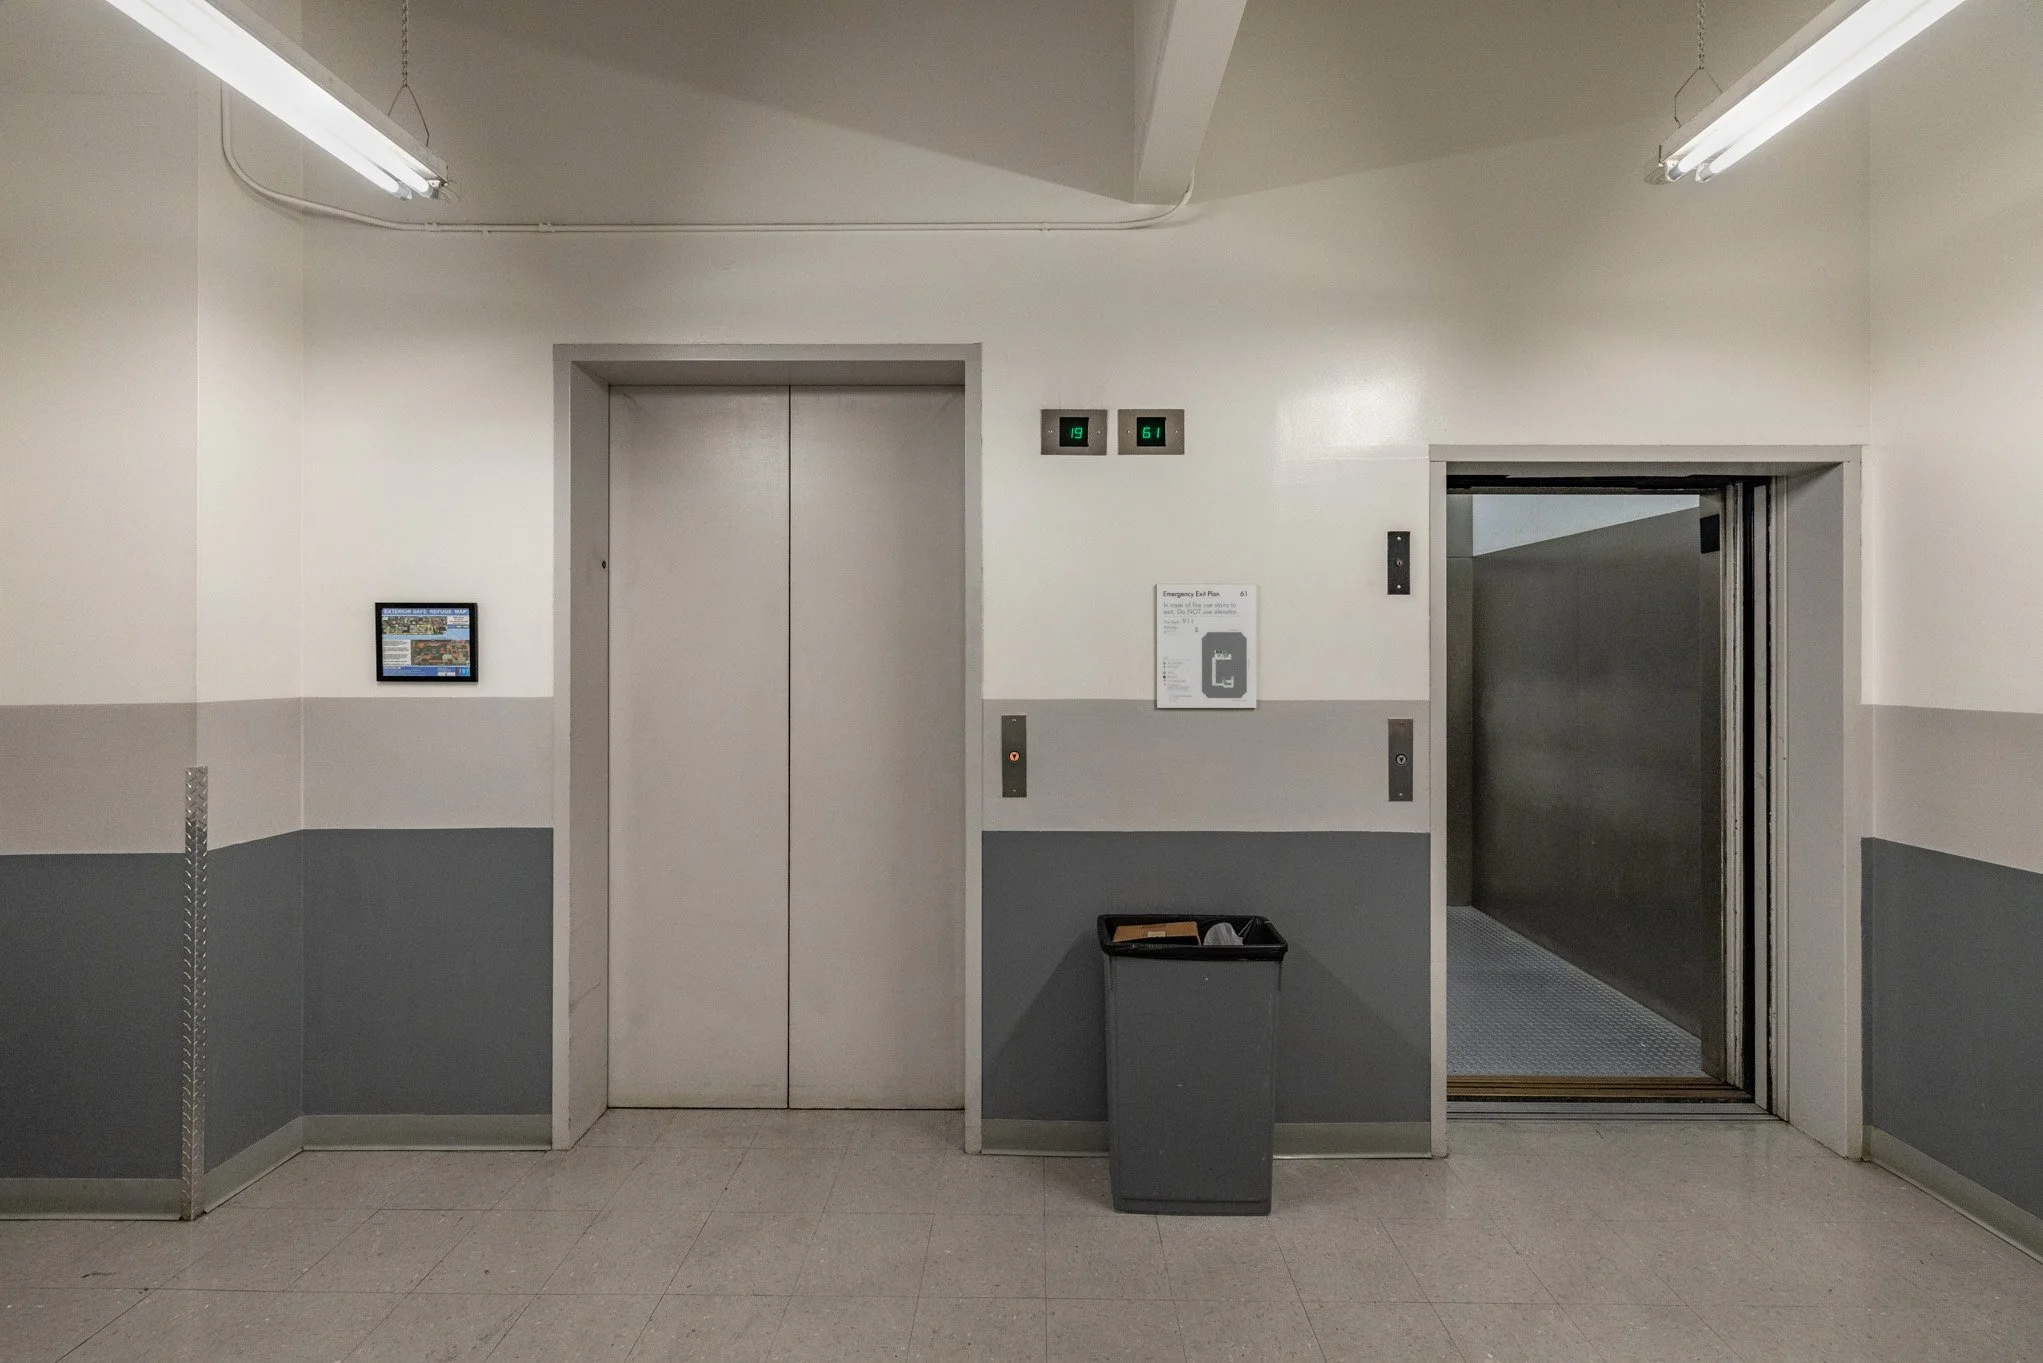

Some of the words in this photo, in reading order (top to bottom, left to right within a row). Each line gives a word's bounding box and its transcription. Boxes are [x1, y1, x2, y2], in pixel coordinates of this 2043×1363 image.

[1071, 427, 1083, 439] 19
[1142, 427, 1160, 439] 61
[1163, 590, 1194, 598] Emergency
